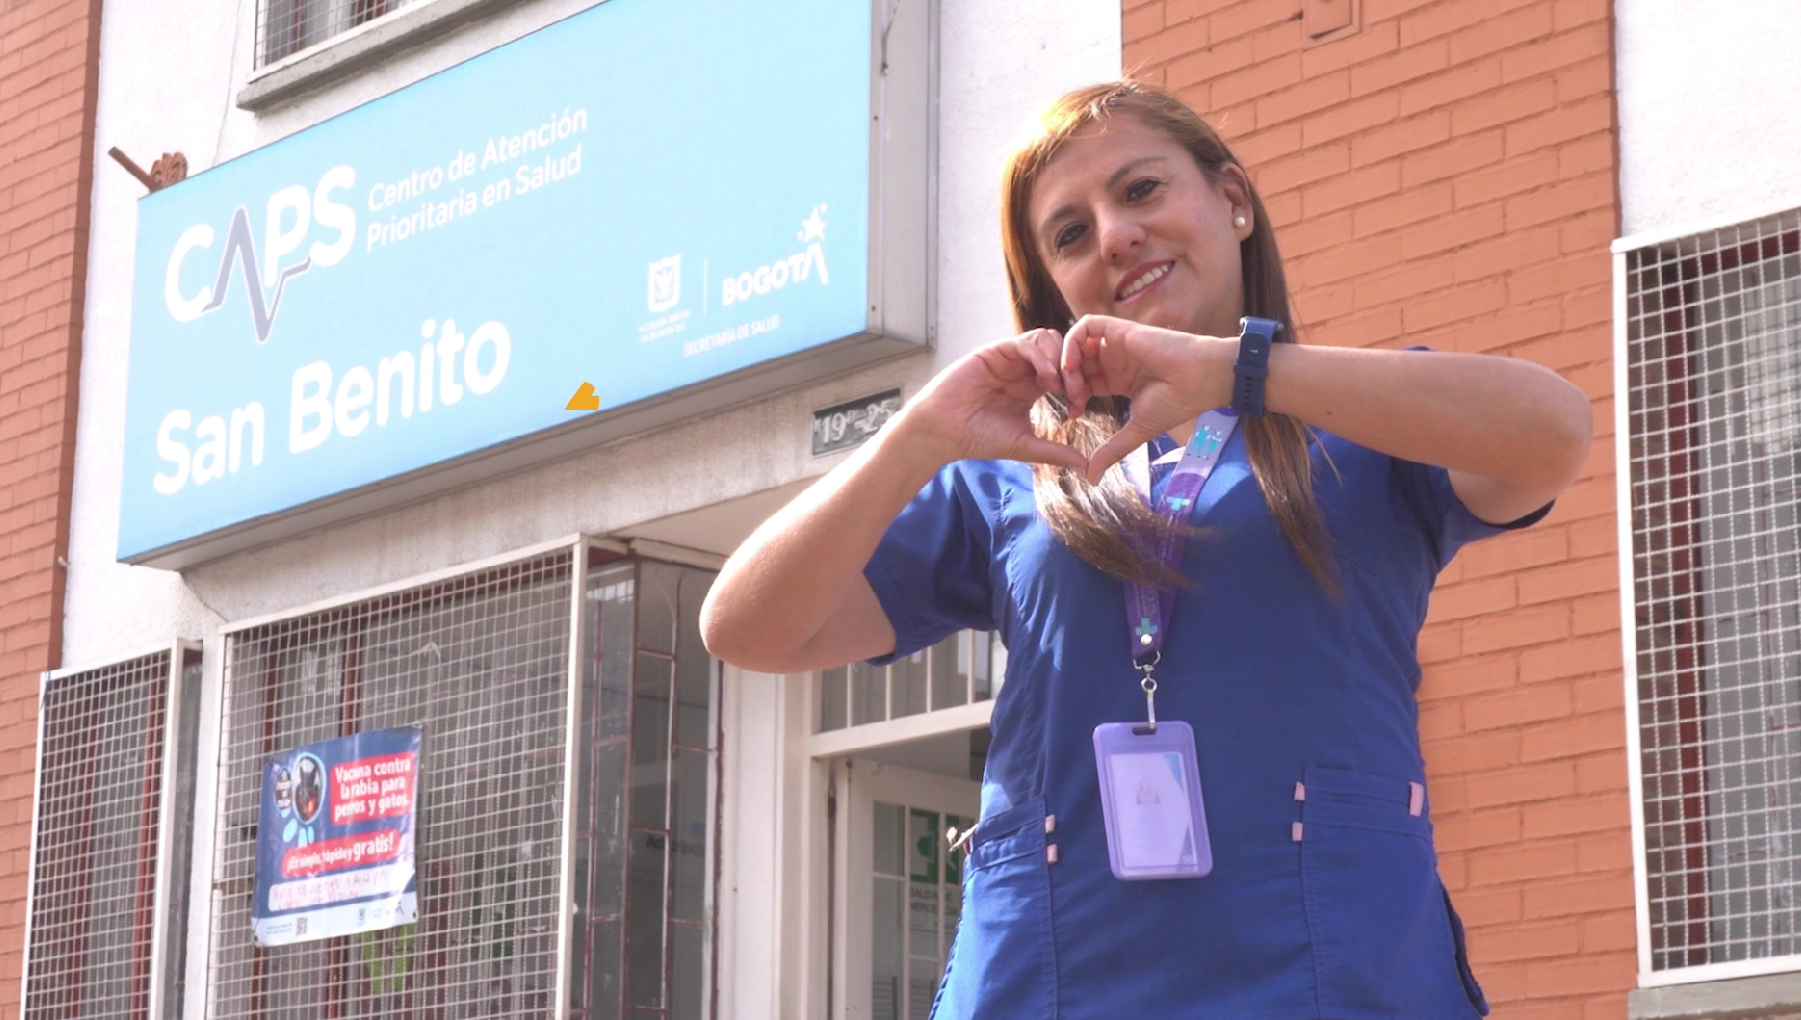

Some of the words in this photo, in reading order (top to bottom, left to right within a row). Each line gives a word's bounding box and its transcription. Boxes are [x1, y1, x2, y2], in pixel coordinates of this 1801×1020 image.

[368, 170, 444, 212] Centro
[448, 150, 476, 182] de
[481, 106, 587, 170] Atención
[366, 189, 479, 252] Prioritaria
[482, 178, 510, 205] en
[515, 144, 582, 196] Salud
[164, 164, 358, 341] CAPS
[683, 327, 736, 358] SECRETARÍA
[737, 323, 750, 340] DE
[751, 314, 781, 335] SALUD
[153, 401, 265, 496] San
[289, 317, 512, 455] Benito
[334, 765, 372, 783] Vacuna
[373, 757, 411, 776] contra
[340, 783, 350, 800] la
[351, 778, 379, 797] rabia
[381, 776, 406, 796] para
[334, 800, 366, 822] perros
[368, 799, 376, 817] y
[378, 793, 410, 815] gatos.
[353, 832, 394, 861] gratis!
